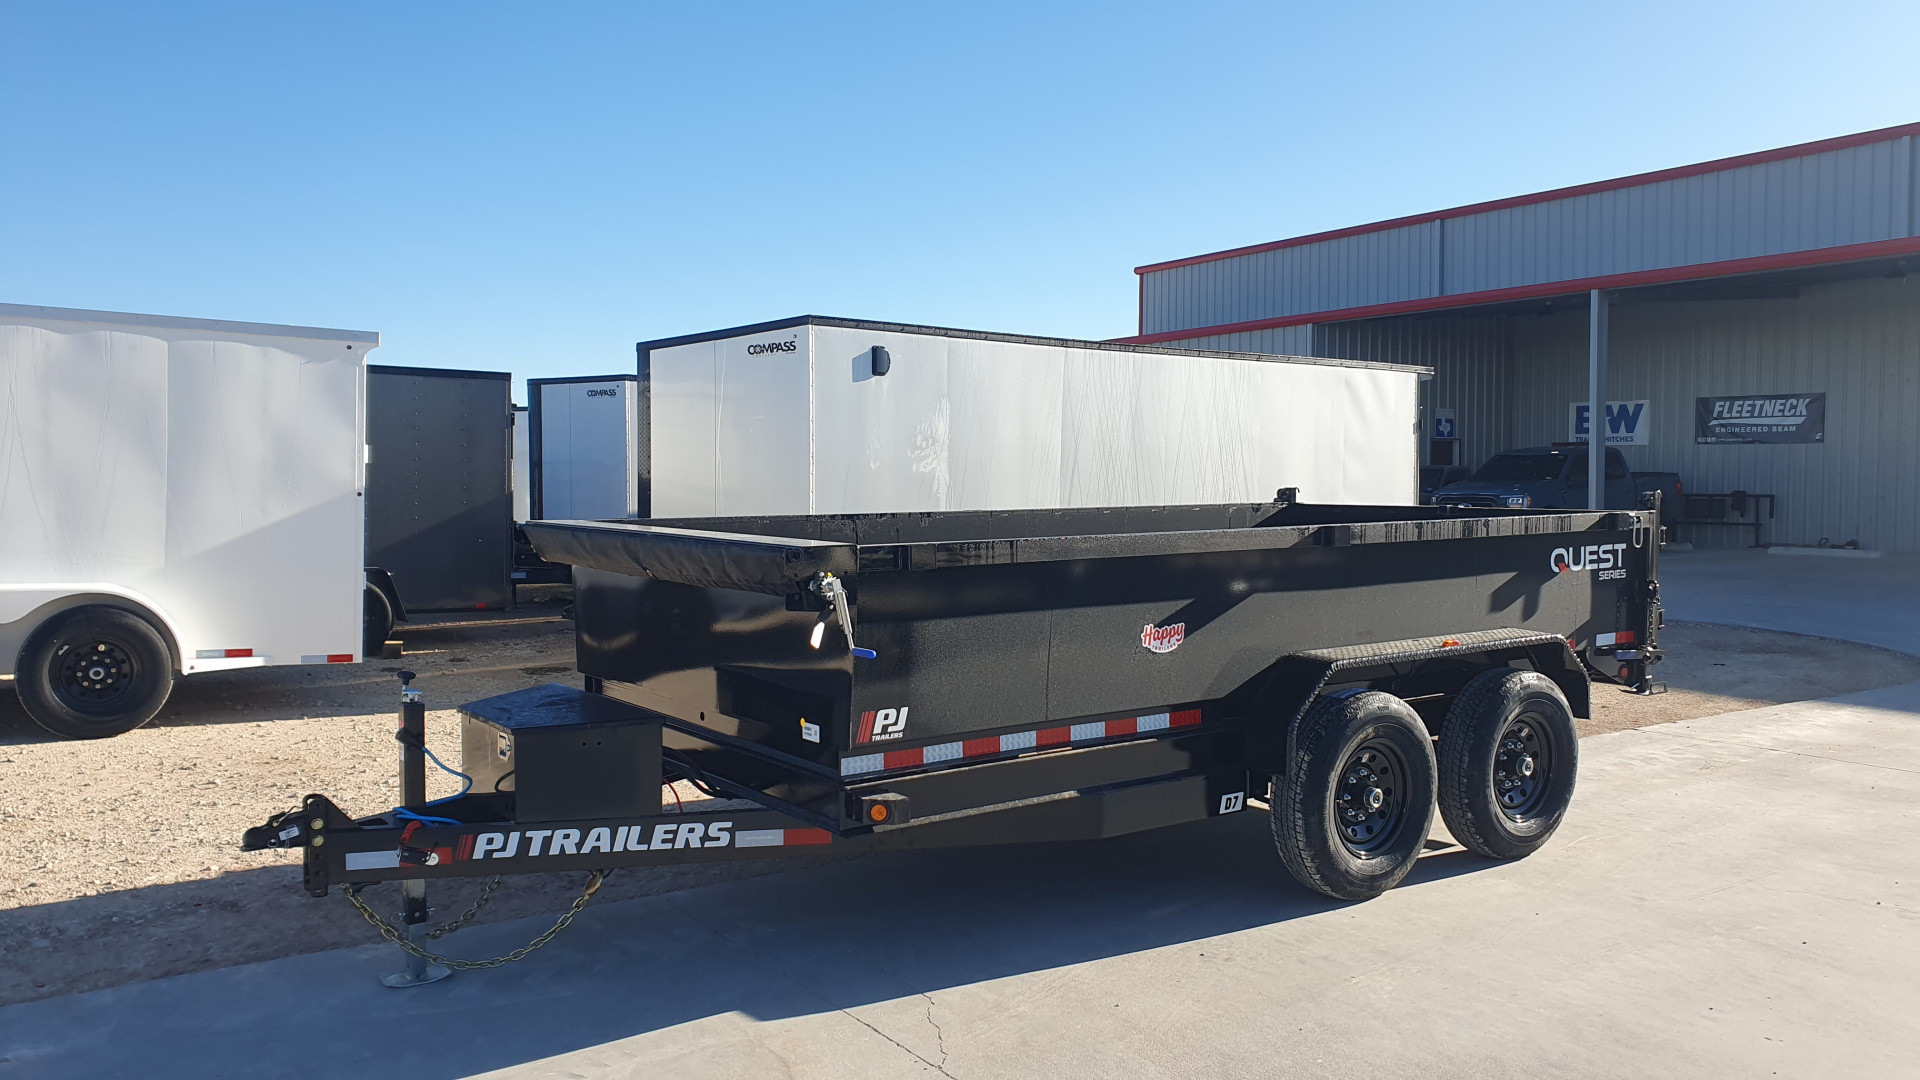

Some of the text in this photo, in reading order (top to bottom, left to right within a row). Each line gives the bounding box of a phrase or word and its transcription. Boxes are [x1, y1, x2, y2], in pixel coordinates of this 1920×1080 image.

[747, 340, 797, 356] COMPASS
[586, 388, 617, 398] COMPASS
[1712, 398, 1811, 418] FLEETNECK
[1550, 543, 1627, 573] QUEST
[1598, 569, 1627, 580] SERIES
[1142, 623, 1184, 646] Happy
[872, 706, 909, 735] PJ
[872, 731, 904, 742] TRAILERS
[1224, 795, 1239, 811] D7
[472, 821, 733, 859] PJ TRAILERS
